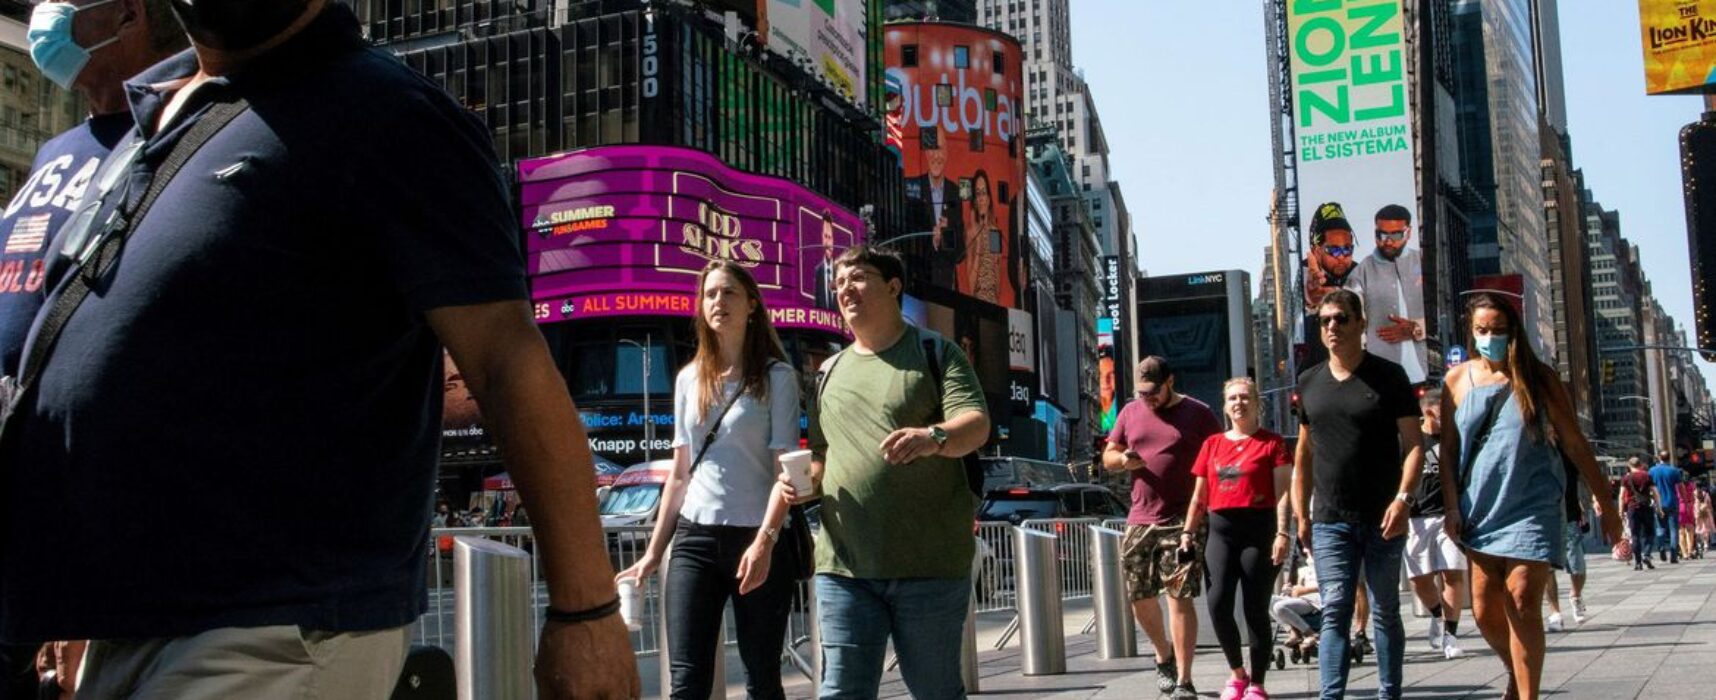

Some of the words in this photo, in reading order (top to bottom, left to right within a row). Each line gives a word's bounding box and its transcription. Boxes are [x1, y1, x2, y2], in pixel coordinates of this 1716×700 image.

[1678, 5, 1698, 17] THE
[1690, 18, 1716, 41] KIN
[1347, 0, 1405, 121] LEN
[885, 67, 1027, 142] Outbai
[1301, 133, 1325, 146] THE
[1327, 130, 1357, 143] NEW
[1360, 125, 1406, 139] ALBUM
[1302, 147, 1322, 161] EL
[1325, 137, 1408, 160] SISTEMA
[3, 153, 100, 220] USA
[551, 205, 615, 224] SUMMER
[0, 260, 45, 293] OLO
[1107, 259, 1119, 300] Locker
[1188, 274, 1224, 285] LinkNYC
[583, 298, 611, 313] ALL
[616, 296, 690, 311] SUMMER
[588, 438, 636, 453] Knapp
